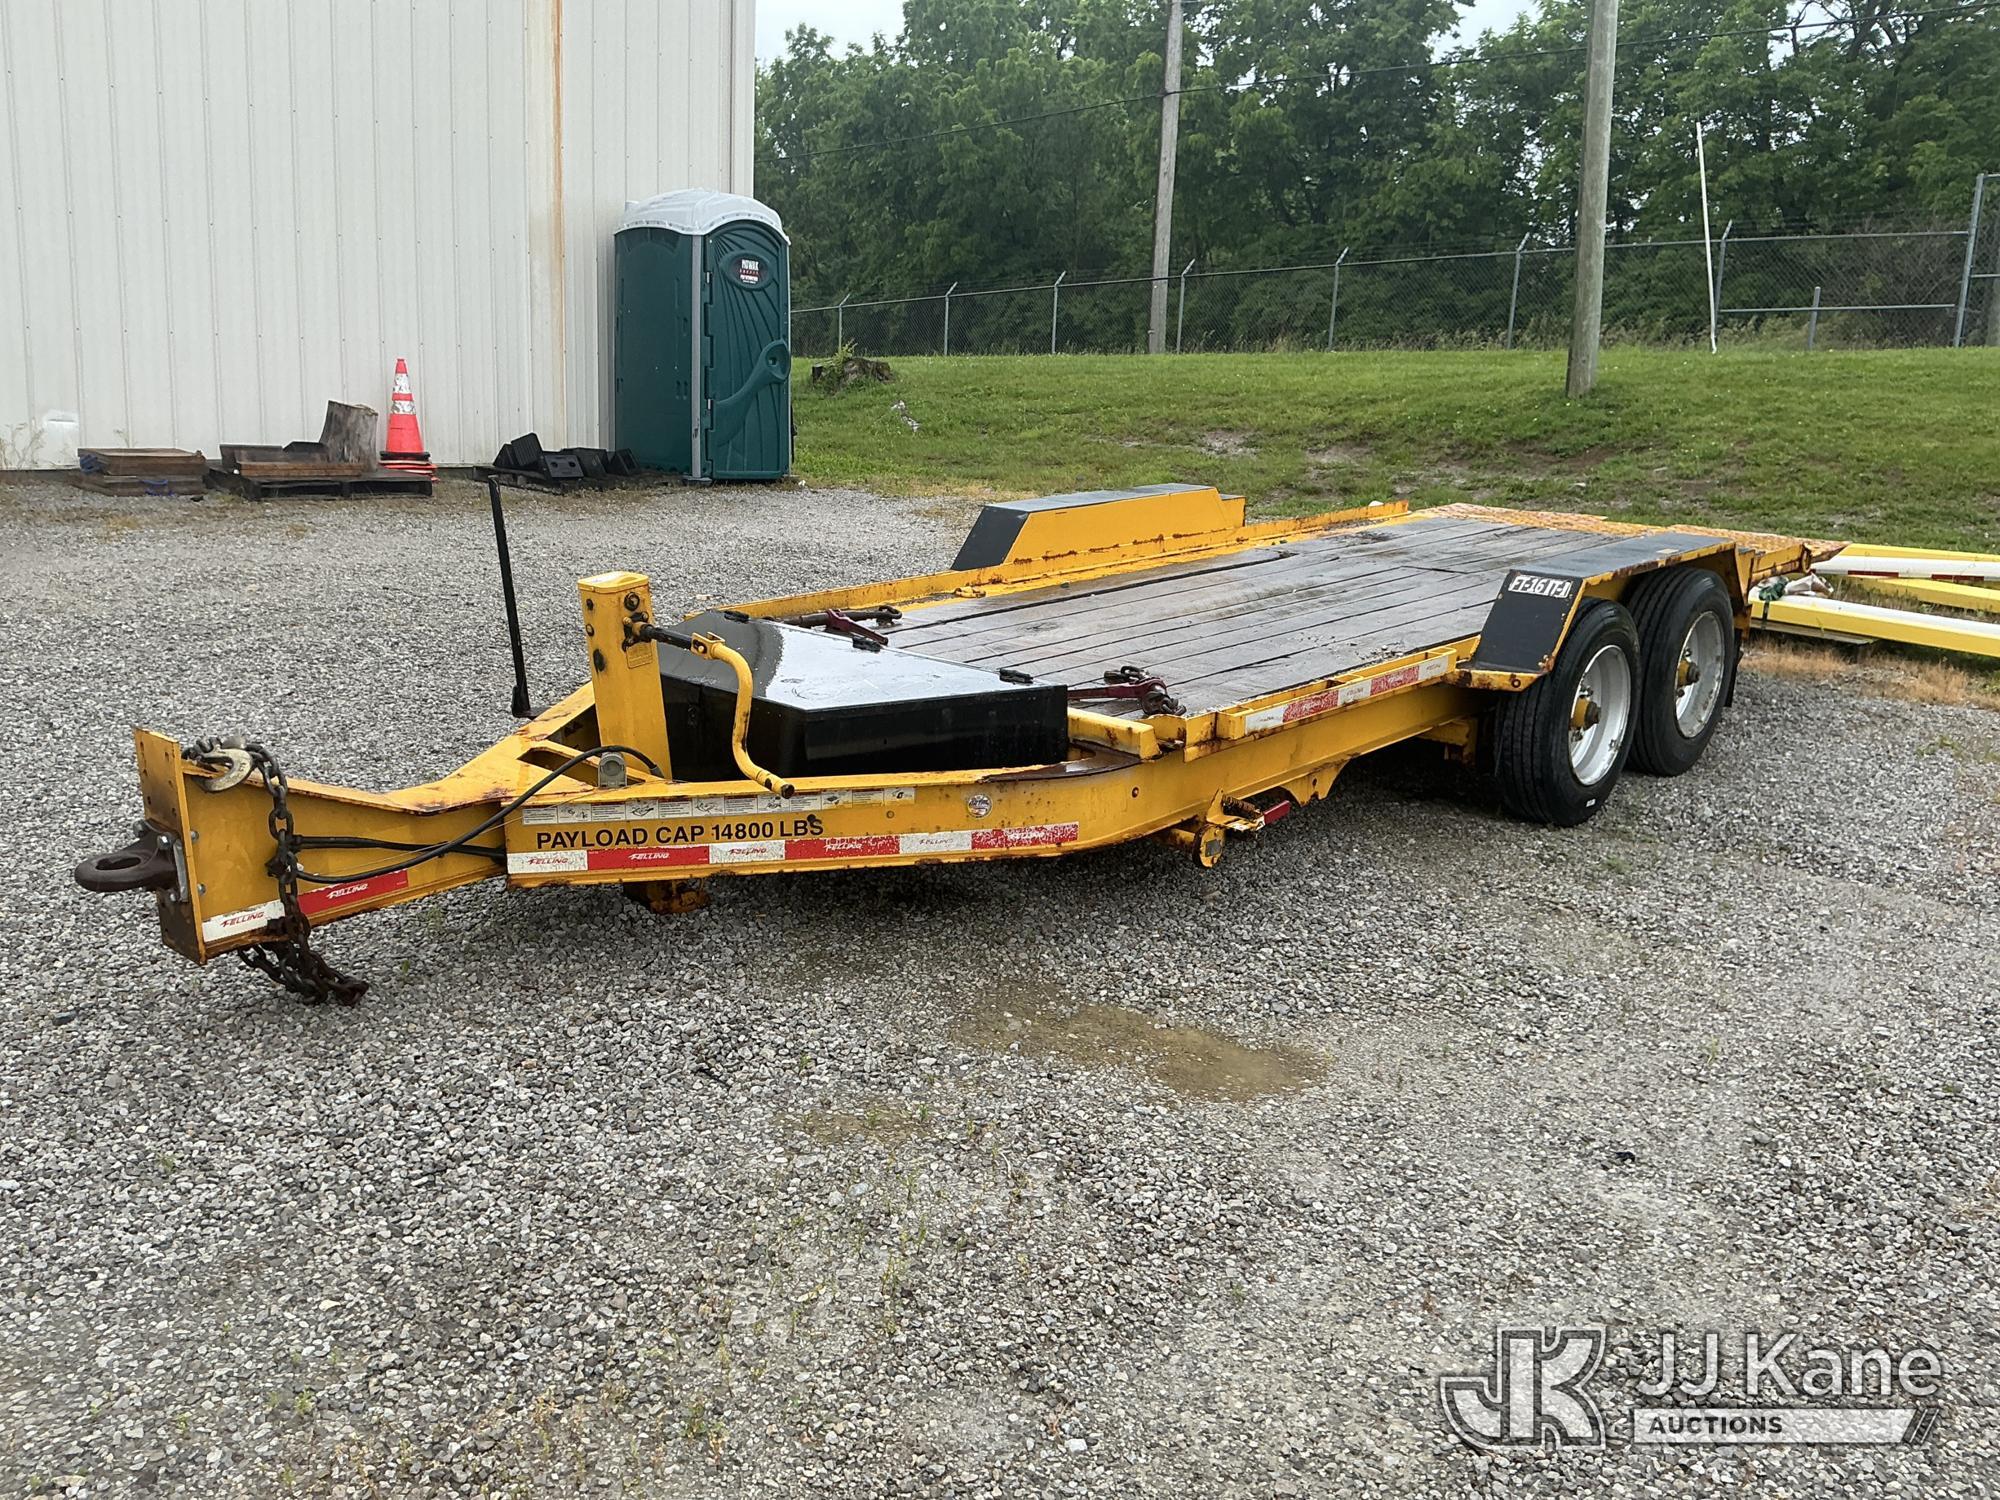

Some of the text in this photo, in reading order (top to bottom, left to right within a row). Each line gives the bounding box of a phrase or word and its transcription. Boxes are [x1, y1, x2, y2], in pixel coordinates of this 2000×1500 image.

[537, 818, 823, 849] PAYLOAD CAP 14800 LBS
[728, 847, 767, 856] FELLING
[823, 842, 863, 852] FELLING
[528, 857, 568, 865] FELLING
[628, 852, 670, 860] FELLING
[326, 883, 369, 899] FELLING
[220, 911, 265, 928] FELLING
